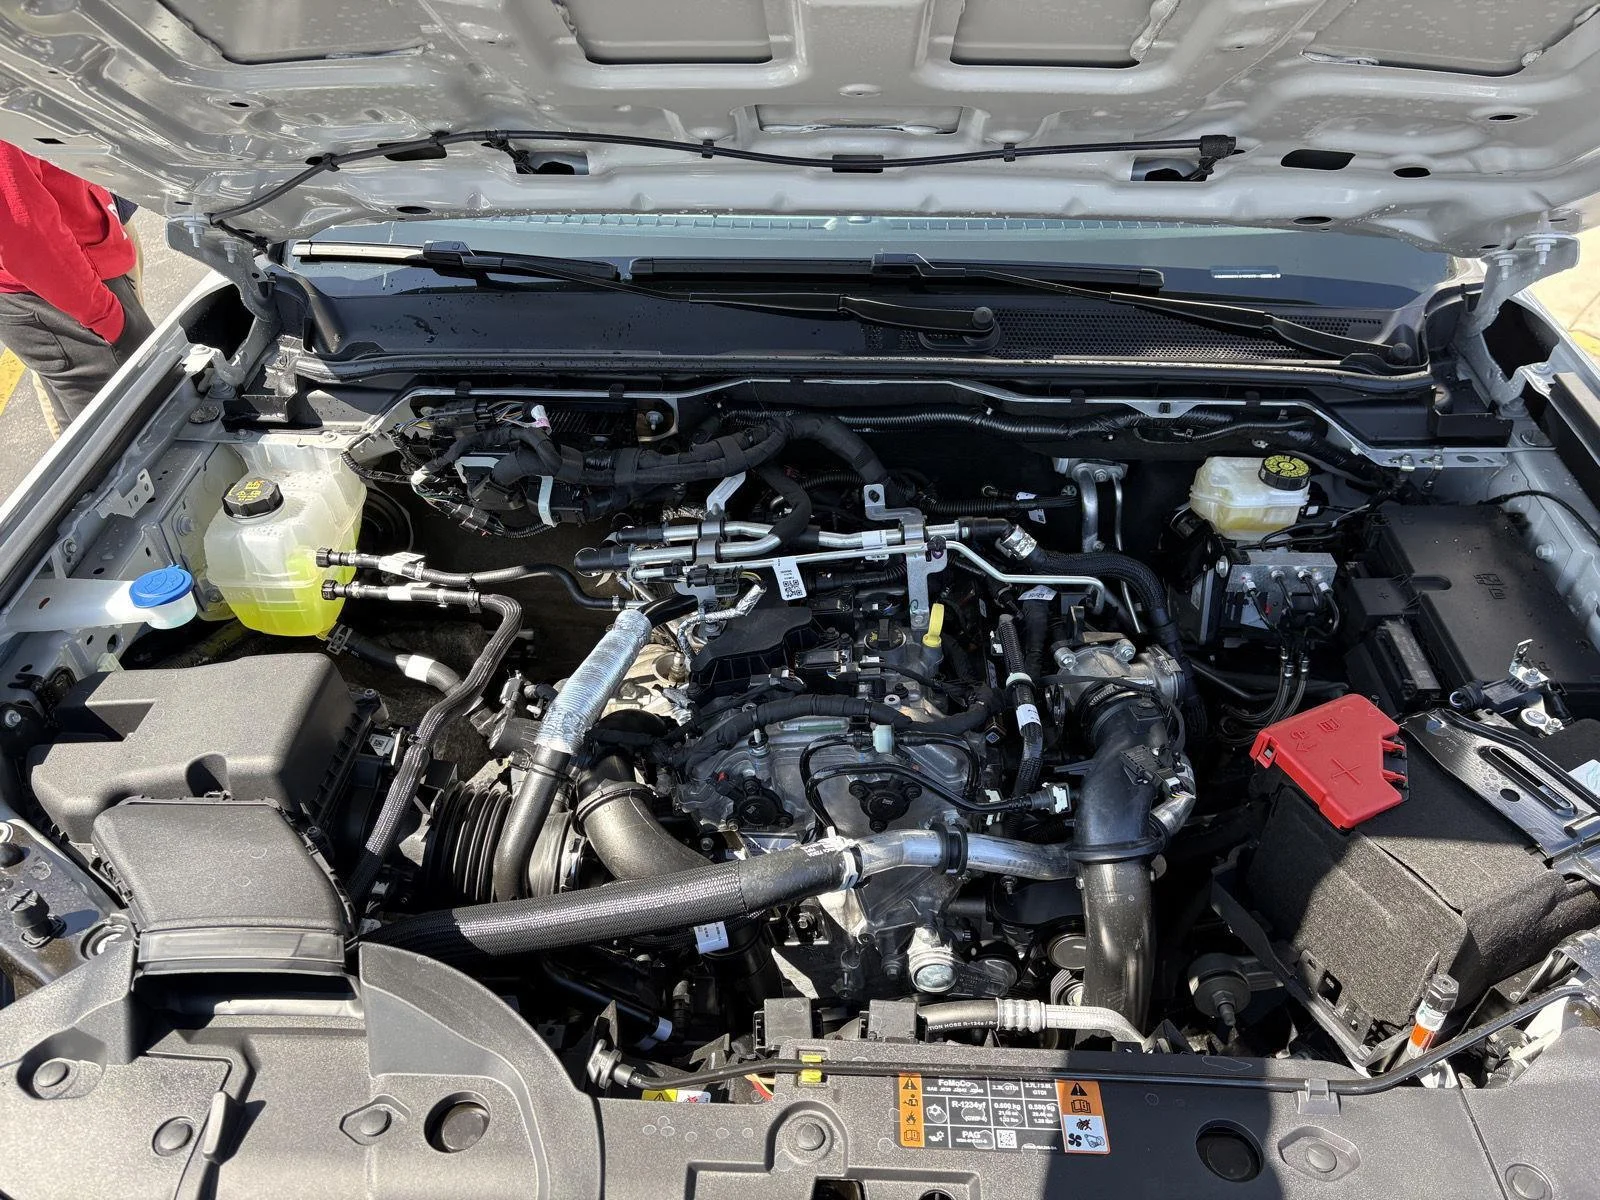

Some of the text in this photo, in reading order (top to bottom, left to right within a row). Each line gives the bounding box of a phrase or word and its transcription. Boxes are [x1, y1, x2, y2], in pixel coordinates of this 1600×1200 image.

[938, 1080, 971, 1088] FoMoCo
[951, 1100, 986, 1110] R-1234yf
[962, 1131, 980, 1139] PAG
